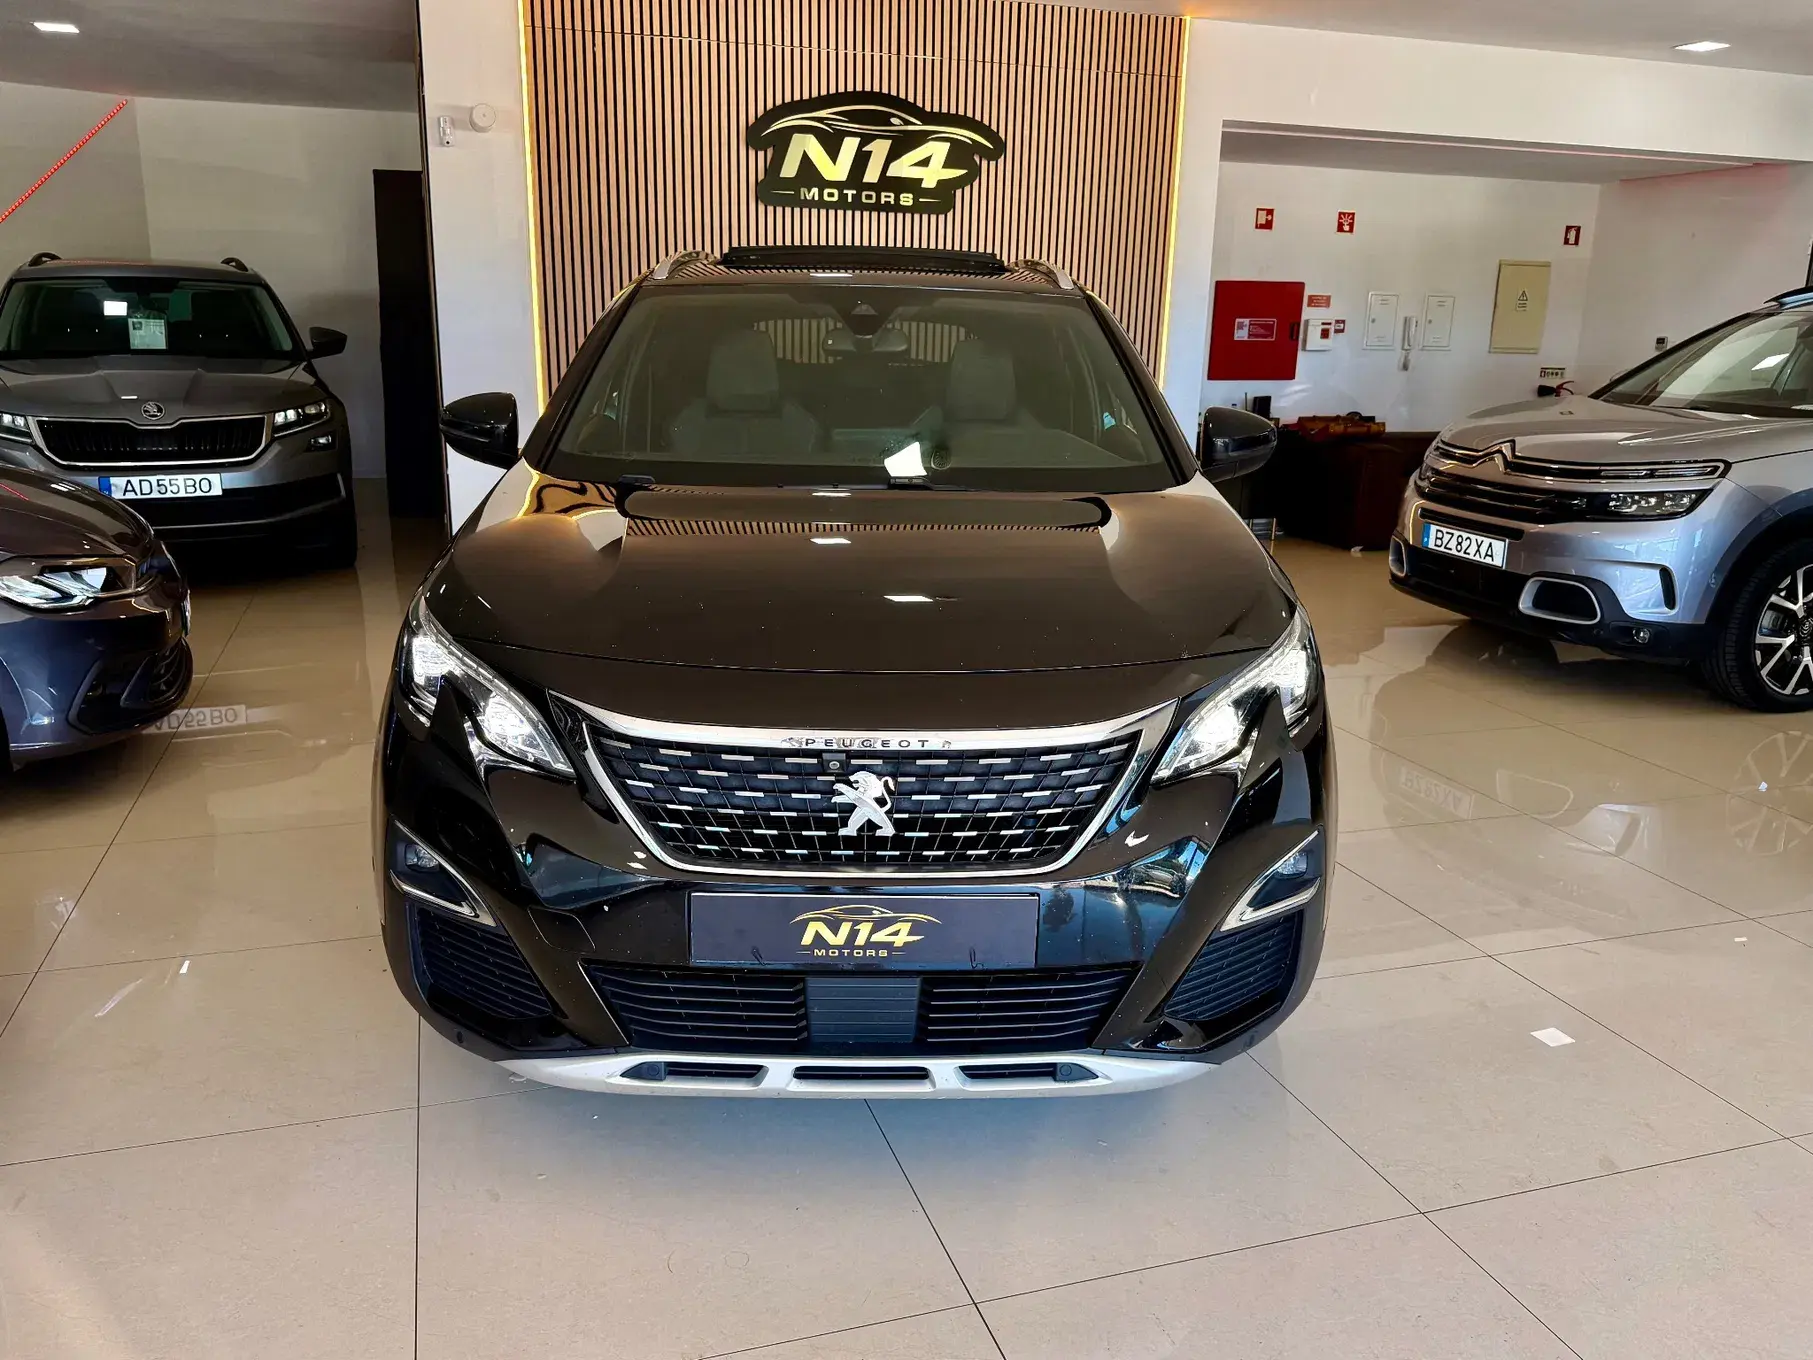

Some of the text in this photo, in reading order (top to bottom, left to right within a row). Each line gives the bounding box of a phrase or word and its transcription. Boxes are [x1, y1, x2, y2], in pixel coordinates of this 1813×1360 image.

[779, 133, 968, 189] N14
[800, 187, 914, 206] MOTORS
[804, 738, 929, 748] PEUGEOT
[800, 921, 925, 947] N14
[813, 949, 888, 957] MOTORS
